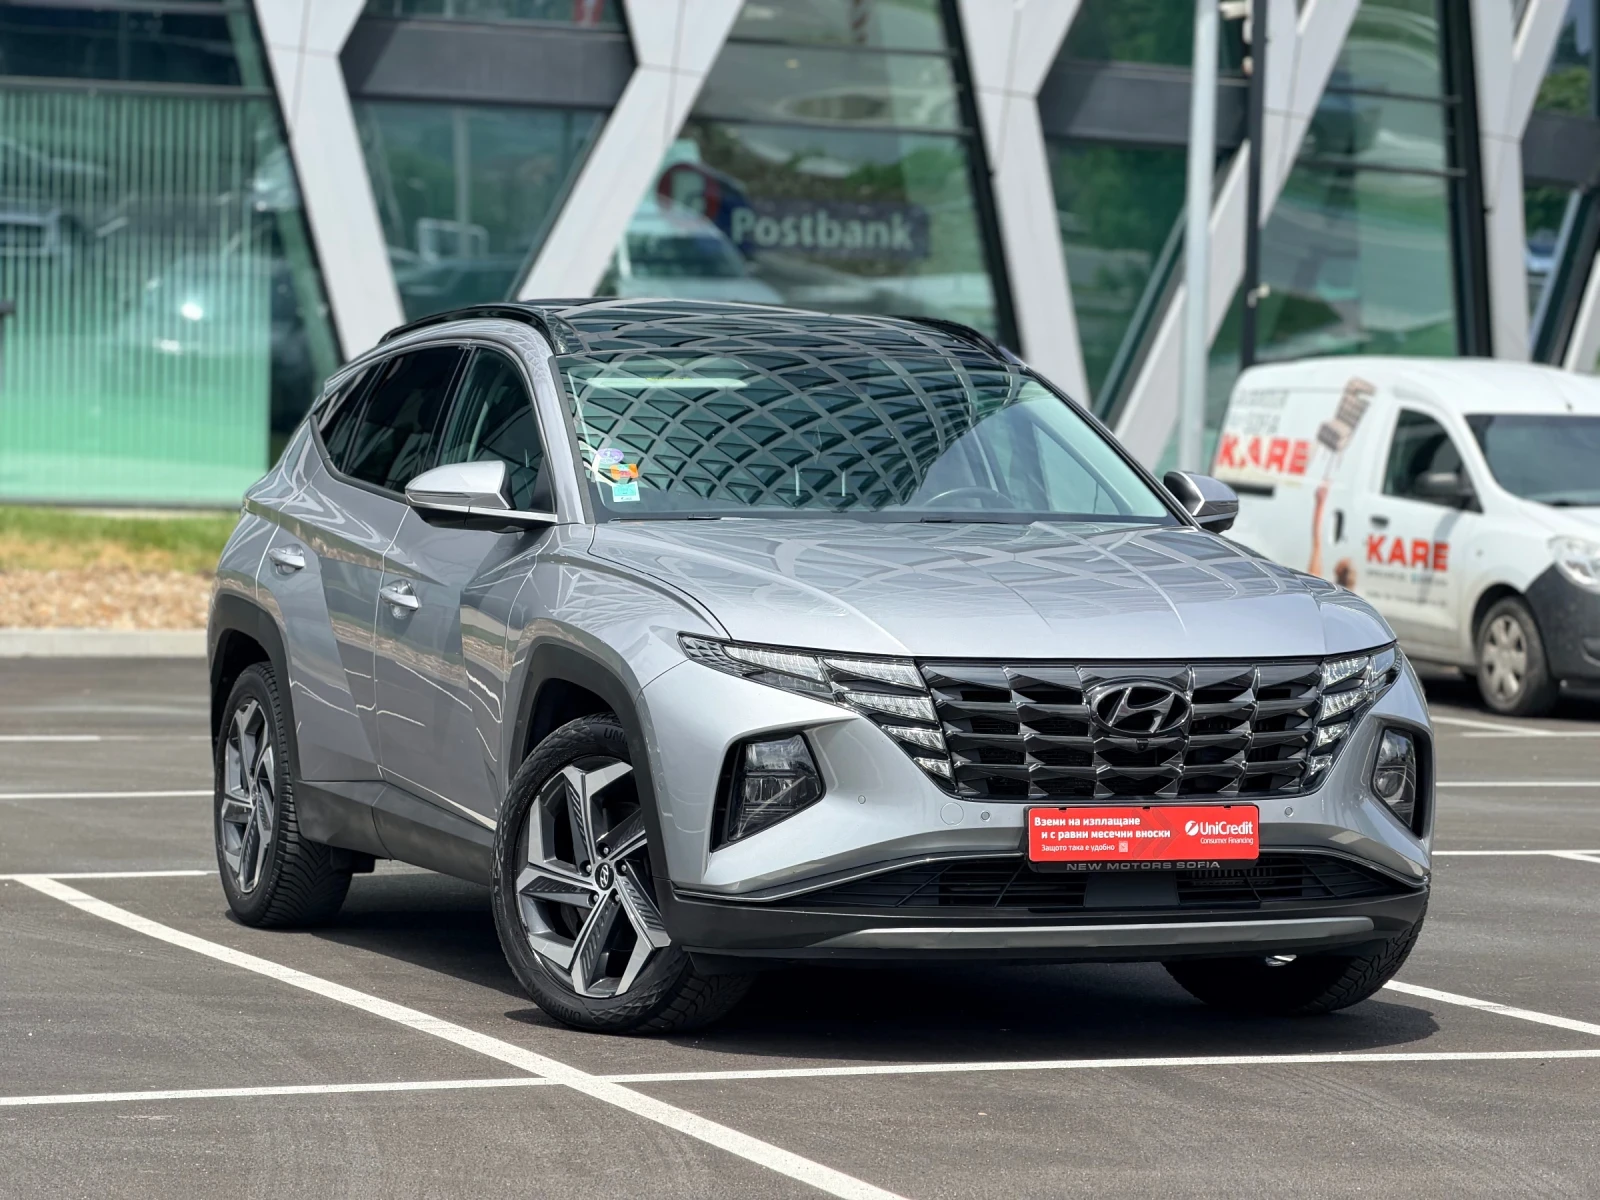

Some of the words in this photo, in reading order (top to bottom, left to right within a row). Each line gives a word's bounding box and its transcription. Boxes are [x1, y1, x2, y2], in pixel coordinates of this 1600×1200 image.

[730, 206, 914, 251] Postbank
[1218, 433, 1312, 476] KARE
[1366, 533, 1449, 572] KARE
[1034, 816, 1066, 826] Вземи
[1068, 818, 1081, 826] на
[1083, 817, 1141, 828] изплащане
[1200, 820, 1254, 835] UniCredit
[1041, 831, 1048, 839] и
[1050, 831, 1056, 839] с
[1058, 831, 1089, 841] равни
[1091, 830, 1133, 839] месечни
[1135, 829, 1171, 838] вноски
[1228, 836, 1254, 846] Financing
[1041, 844, 1067, 852] Защото
[1091, 843, 1115, 852] удобно
[1066, 862, 1102, 871] NEW
[1106, 861, 1172, 870] MOTORS
[1176, 861, 1221, 869] SOFIA
